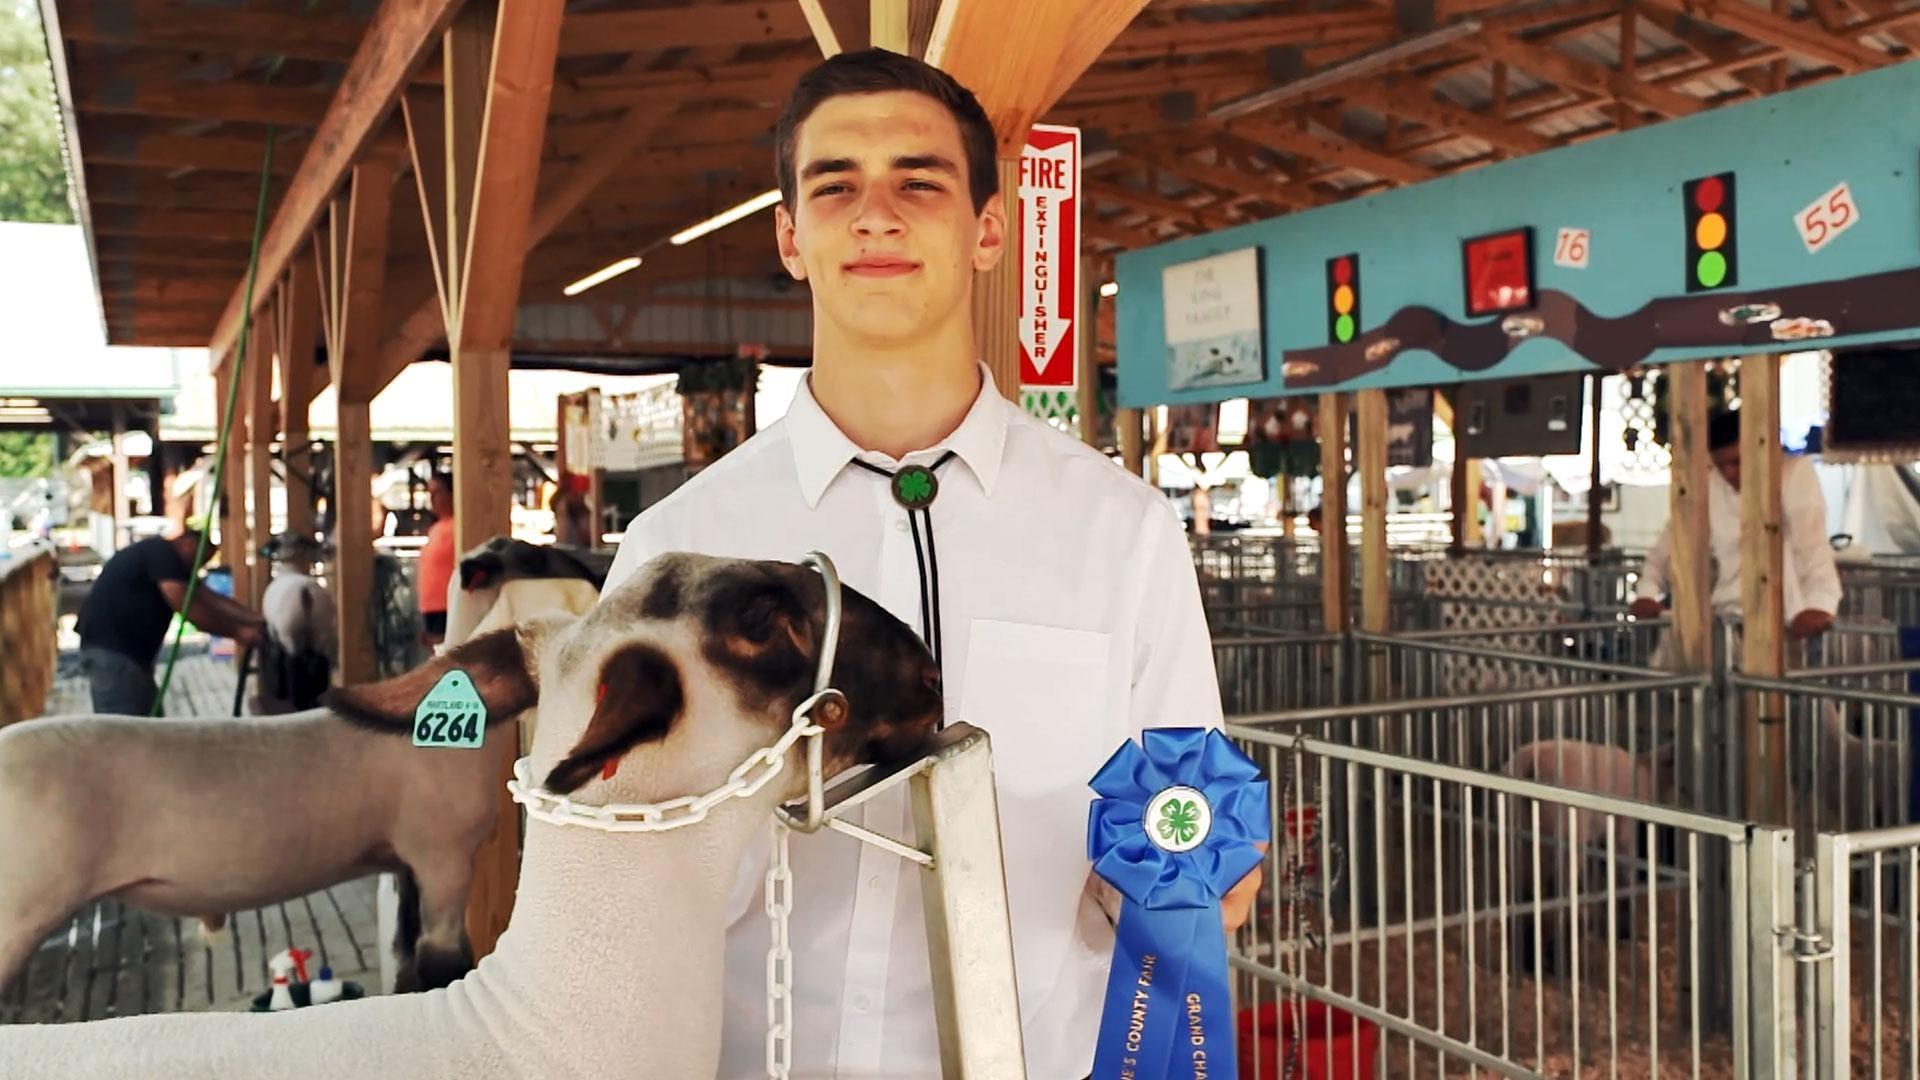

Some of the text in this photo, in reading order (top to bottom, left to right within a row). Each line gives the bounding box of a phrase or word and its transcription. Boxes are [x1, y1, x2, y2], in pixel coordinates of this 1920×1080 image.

[1018, 157, 1066, 189] FIRE
[1805, 188, 1850, 245] 55
[1556, 231, 1588, 262] 16
[1034, 196, 1048, 358] EXTINGUISHER
[416, 712, 478, 743] 6264
[1137, 954, 1158, 987] FAIR
[1126, 990, 1150, 1052] COUNTY
[1186, 993, 1208, 1080] GRAND CHA
